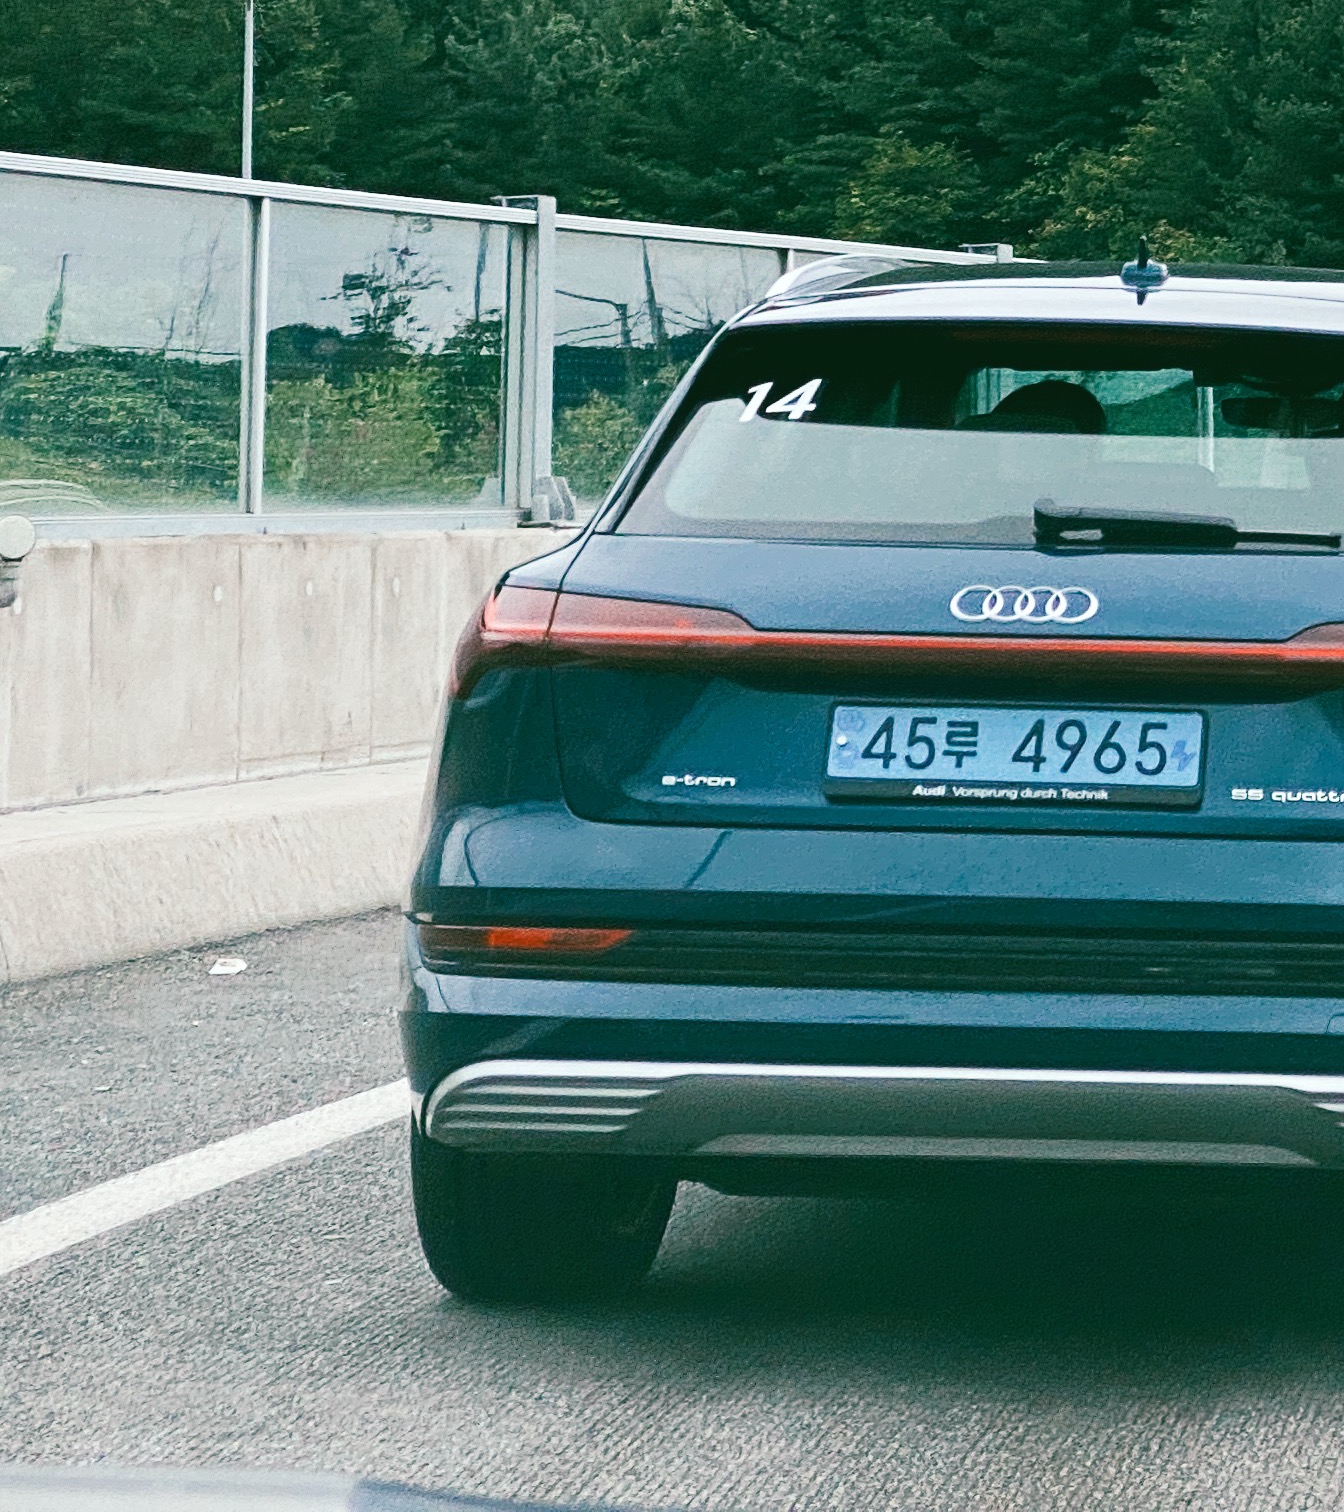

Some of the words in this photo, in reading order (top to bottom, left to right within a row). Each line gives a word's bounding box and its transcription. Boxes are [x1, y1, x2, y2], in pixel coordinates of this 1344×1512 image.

[739, 378, 823, 423] 14
[861, 716, 980, 769] 45루
[1011, 718, 1169, 776] 4965
[661, 774, 736, 787] e-tron
[912, 785, 946, 797] Audi
[952, 785, 1018, 800] Vorsprung
[1020, 787, 1057, 799] durch
[1060, 788, 1109, 800] Technik
[1231, 788, 1264, 801] 55
